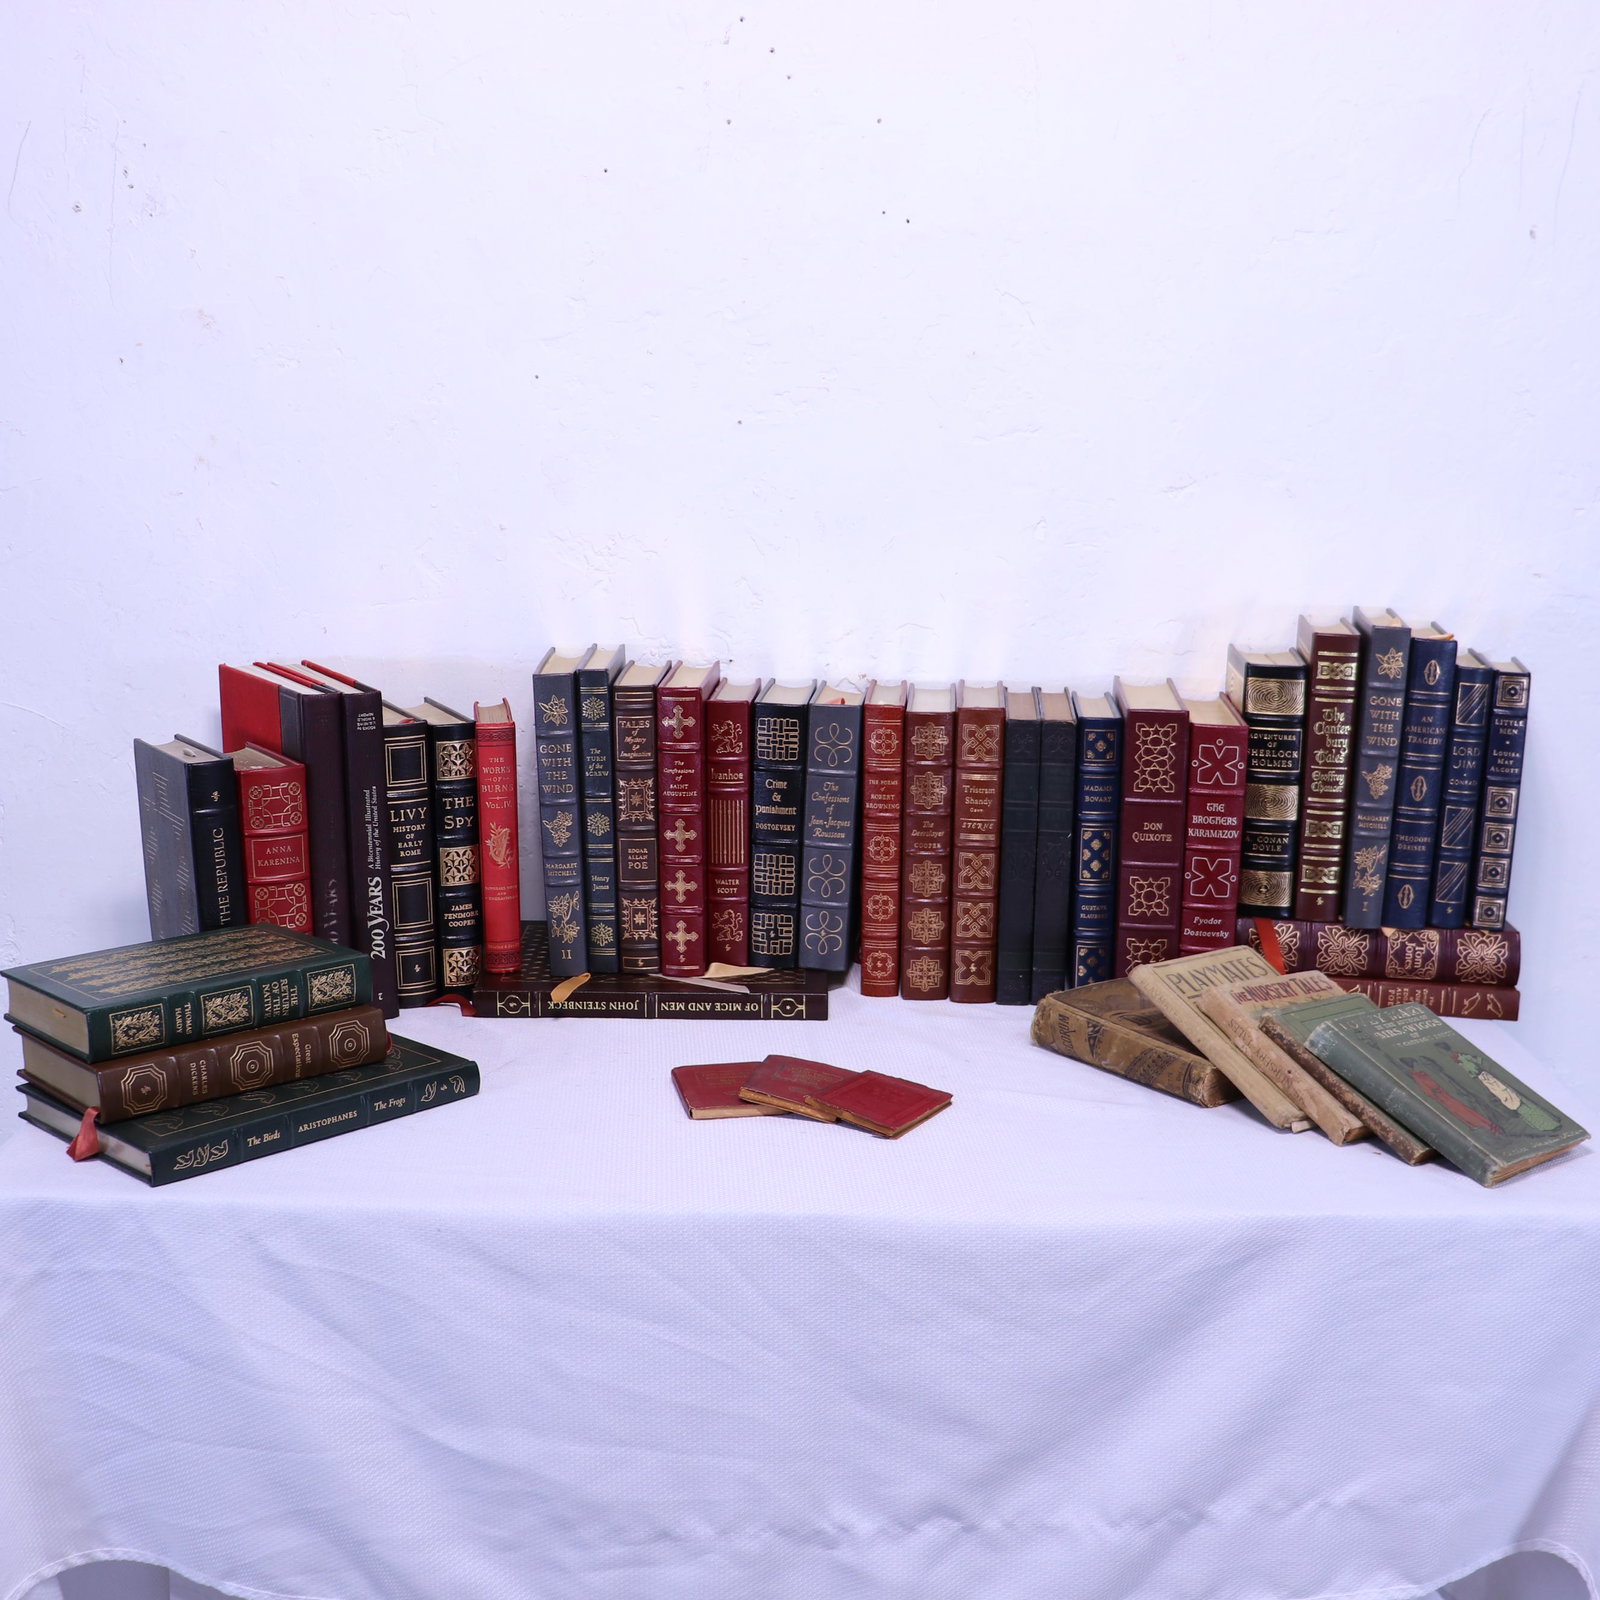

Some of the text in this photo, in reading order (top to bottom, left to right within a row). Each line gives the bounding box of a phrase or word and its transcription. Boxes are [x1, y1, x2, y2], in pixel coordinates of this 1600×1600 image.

[1369, 696, 1402, 707] GONE
[1322, 707, 1345, 723] The
[1369, 709, 1400, 720] WITH
[619, 720, 650, 728] TALES
[1313, 722, 1351, 735] Canter
[1372, 723, 1394, 733] THE
[1495, 719, 1525, 727] LITTLE
[632, 728, 639, 736] of
[1405, 725, 1446, 734] AMERICAN
[1499, 727, 1519, 735] MEN
[624, 736, 647, 744] Mystery
[1326, 734, 1348, 753] bury
[1366, 736, 1398, 747] WIND
[1407, 735, 1442, 745] TRAGEDY
[540, 744, 572, 754] GONE
[1453, 746, 1480, 757] LORD
[541, 757, 572, 767] WITH
[1313, 749, 1345, 764] Tales
[1251, 759, 1293, 767] HOLMES
[1452, 760, 1476, 769] JIM
[482, 766, 511, 774] WORKS
[546, 771, 568, 780] THE
[711, 768, 744, 780] Ivanhoe
[1490, 766, 1520, 774] ALCOTT
[1311, 771, 1345, 784] Geoffrey
[481, 784, 514, 792] BURNS
[542, 783, 574, 794] WIND
[765, 779, 788, 789] Crime
[823, 781, 839, 791] The
[962, 785, 996, 794] Tristram
[1311, 781, 1344, 793] Chaucer
[772, 792, 781, 802] &
[811, 791, 850, 804] Confessions
[965, 796, 993, 807] Shandy
[1084, 795, 1112, 803] BOVARY
[363, 789, 371, 821] Illustrated
[442, 796, 475, 810] THE
[1206, 802, 1225, 812] THE
[390, 807, 427, 822] LIVY
[826, 804, 835, 815] of
[808, 815, 851, 829] Jean-Jacques
[1192, 815, 1238, 826] BROTHERS
[393, 823, 426, 833] HISTORY
[755, 822, 796, 832] DOSTOEVSKY
[1143, 822, 1163, 831] DON
[812, 827, 846, 839] Rousseau
[911, 829, 945, 838] Deerslayer
[1132, 832, 1173, 843] QUIXOTE
[1188, 828, 1240, 839] KARAMAZOV
[1395, 834, 1431, 843] THEODORE
[365, 824, 374, 862] Bicentennial
[398, 840, 423, 849] EARLY
[1257, 836, 1289, 844] CONAN
[265, 845, 292, 855] ANNA
[400, 848, 421, 857] ROME
[258, 857, 300, 867] KARENINA
[374, 847, 382, 870] History
[628, 861, 648, 870] POE
[213, 827, 231, 925] THE REPUBLIC
[591, 875, 610, 883] Henry
[451, 903, 473, 911] JAMES
[367, 876, 390, 960] 200 YEARS
[444, 910, 478, 919] FENIMORE
[448, 919, 476, 927] COOPER
[1193, 916, 1222, 925] Fyodor
[1183, 928, 1230, 939] Dostoevsky
[561, 949, 572, 960] II
[1405, 941, 1416, 970] Jones
[1414, 944, 1426, 968] Tom
[1165, 956, 1269, 995] PLAYMATES
[1242, 981, 1298, 1003] NURSERY
[1289, 974, 1333, 995] TALES
[262, 984, 272, 1019] NATIVE
[272, 981, 281, 1018] OF THE
[280, 978, 290, 1016] RETURN
[290, 986, 298, 1006] THE
[1388, 989, 1396, 1006] POE
[547, 1000, 639, 1010] JOHN STEINBECK
[660, 1002, 759, 1011] OF MICE AND MEN
[175, 1008, 183, 1033] HARDY
[184, 1002, 193, 1035] THOMAS
[1402, 1019, 1442, 1032] WIGGS
[291, 1033, 301, 1078] Expectations
[304, 1044, 312, 1064] Great
[189, 1062, 198, 1096] DICKENS
[199, 1060, 208, 1095] CHARLES
[373, 1096, 406, 1111] The Frogs
[298, 1110, 358, 1133] ARISTOPHANES
[247, 1129, 281, 1148] The Birds
